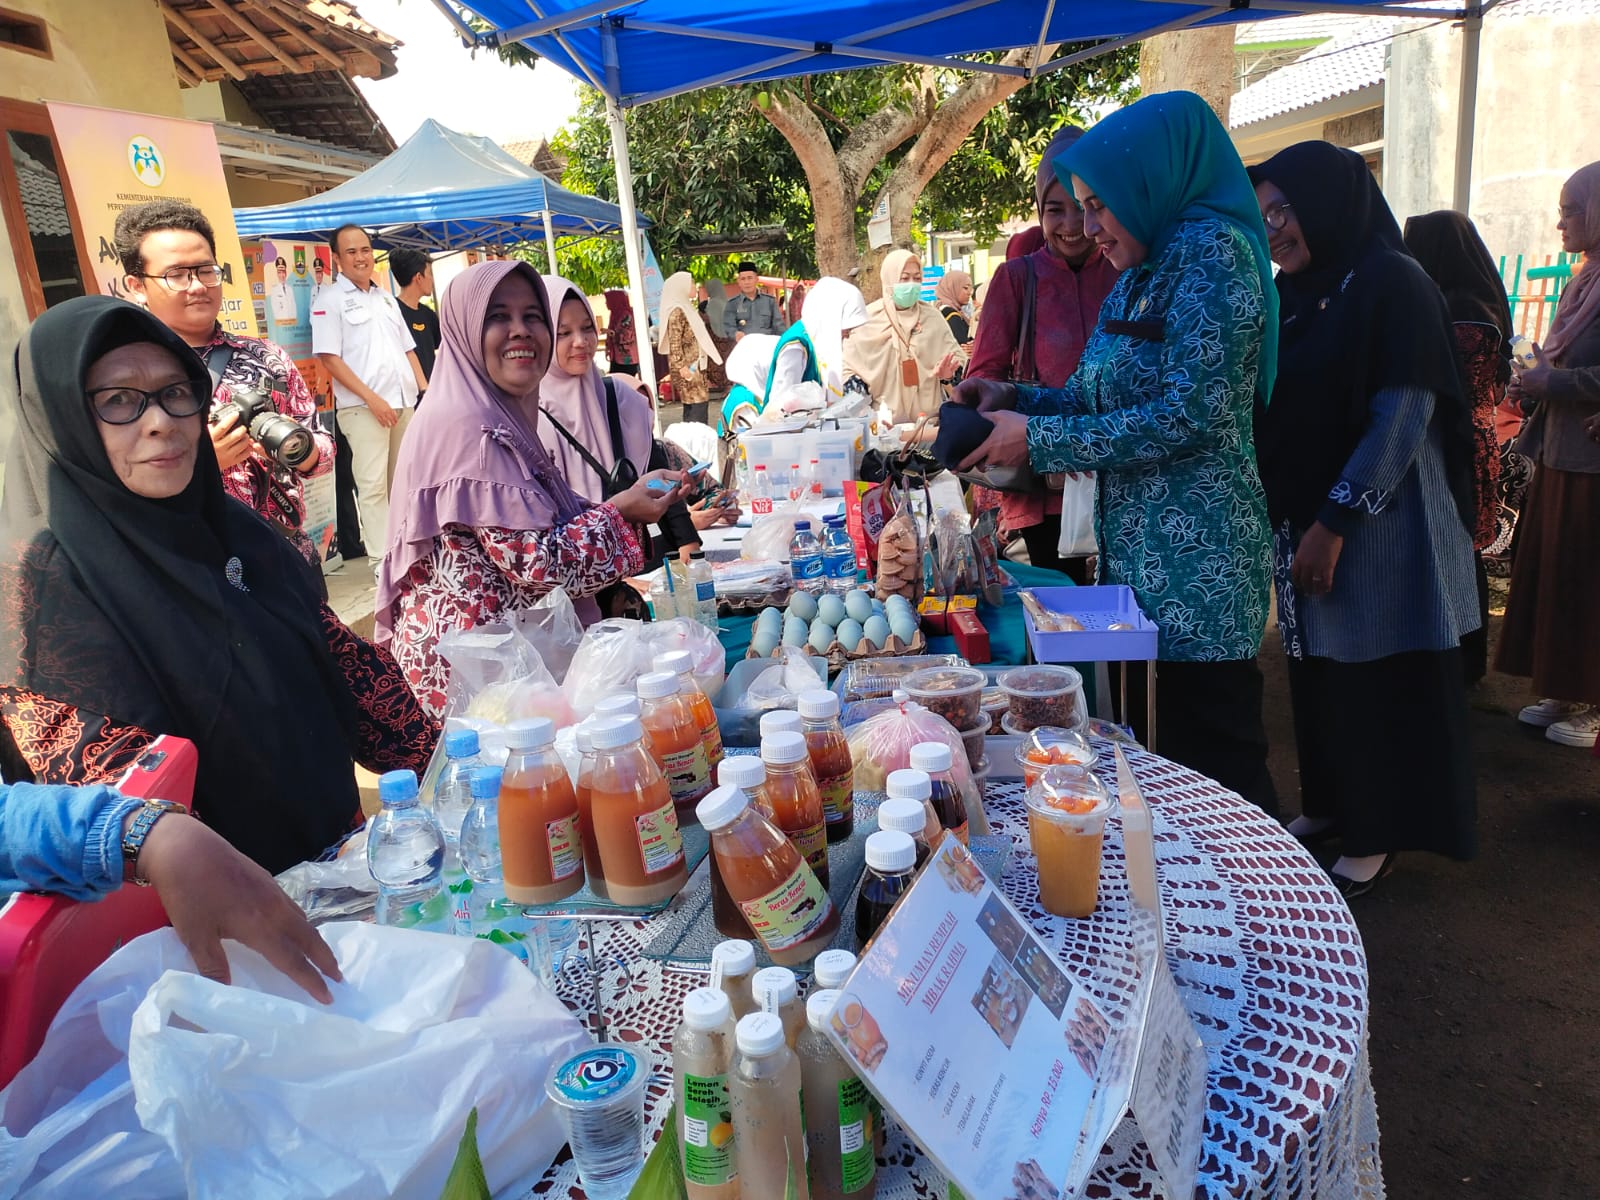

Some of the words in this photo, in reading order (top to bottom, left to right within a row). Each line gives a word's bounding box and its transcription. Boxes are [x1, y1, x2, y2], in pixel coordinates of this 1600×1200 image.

[225, 318, 248, 332] Tua
[270, 486, 294, 514] Canon
[897, 949, 933, 1003] MINUMAN
[928, 910, 957, 953] REMPAH
[921, 972, 947, 1010] MBAK
[940, 940, 966, 978] RAHMA
[687, 1078, 720, 1088] Lemon
[687, 1086, 714, 1096] Sereh
[1030, 1107, 1048, 1140] Hanya
[1047, 1058, 1064, 1093] 15.000
